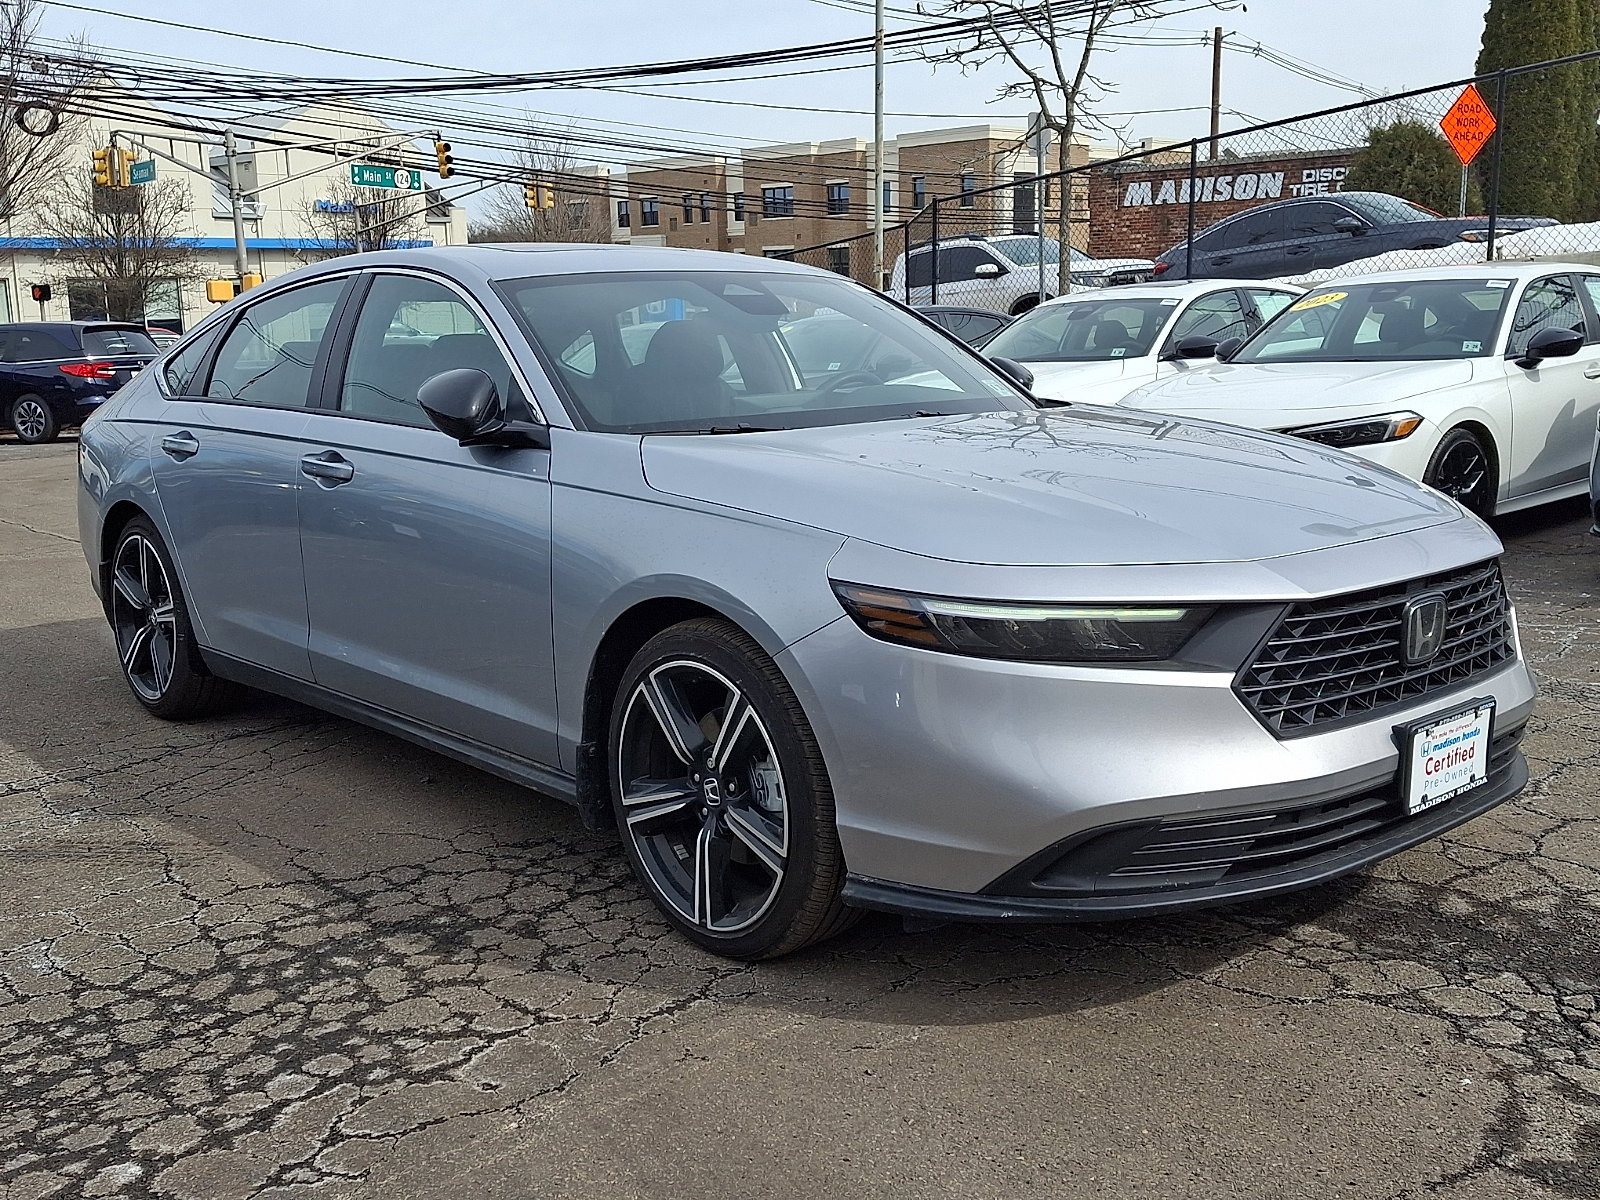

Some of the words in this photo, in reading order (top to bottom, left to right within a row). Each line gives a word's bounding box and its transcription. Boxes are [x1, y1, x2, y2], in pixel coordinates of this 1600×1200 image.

[1457, 103, 1482, 114] ROAD
[1456, 117, 1480, 128] WORK
[1453, 131, 1484, 141] AHEAD
[363, 169, 382, 183] Main
[396, 173, 409, 185] 124
[1123, 171, 1285, 207] MADISON
[1289, 182, 1330, 197] TIRE
[1432, 736, 1460, 752] madison
[1461, 726, 1481, 742] honda
[1425, 741, 1476, 775] Certified
[1424, 762, 1474, 791] Pre-Owned
[1410, 790, 1456, 815] MADISON
[1456, 776, 1488, 796] HONDA
